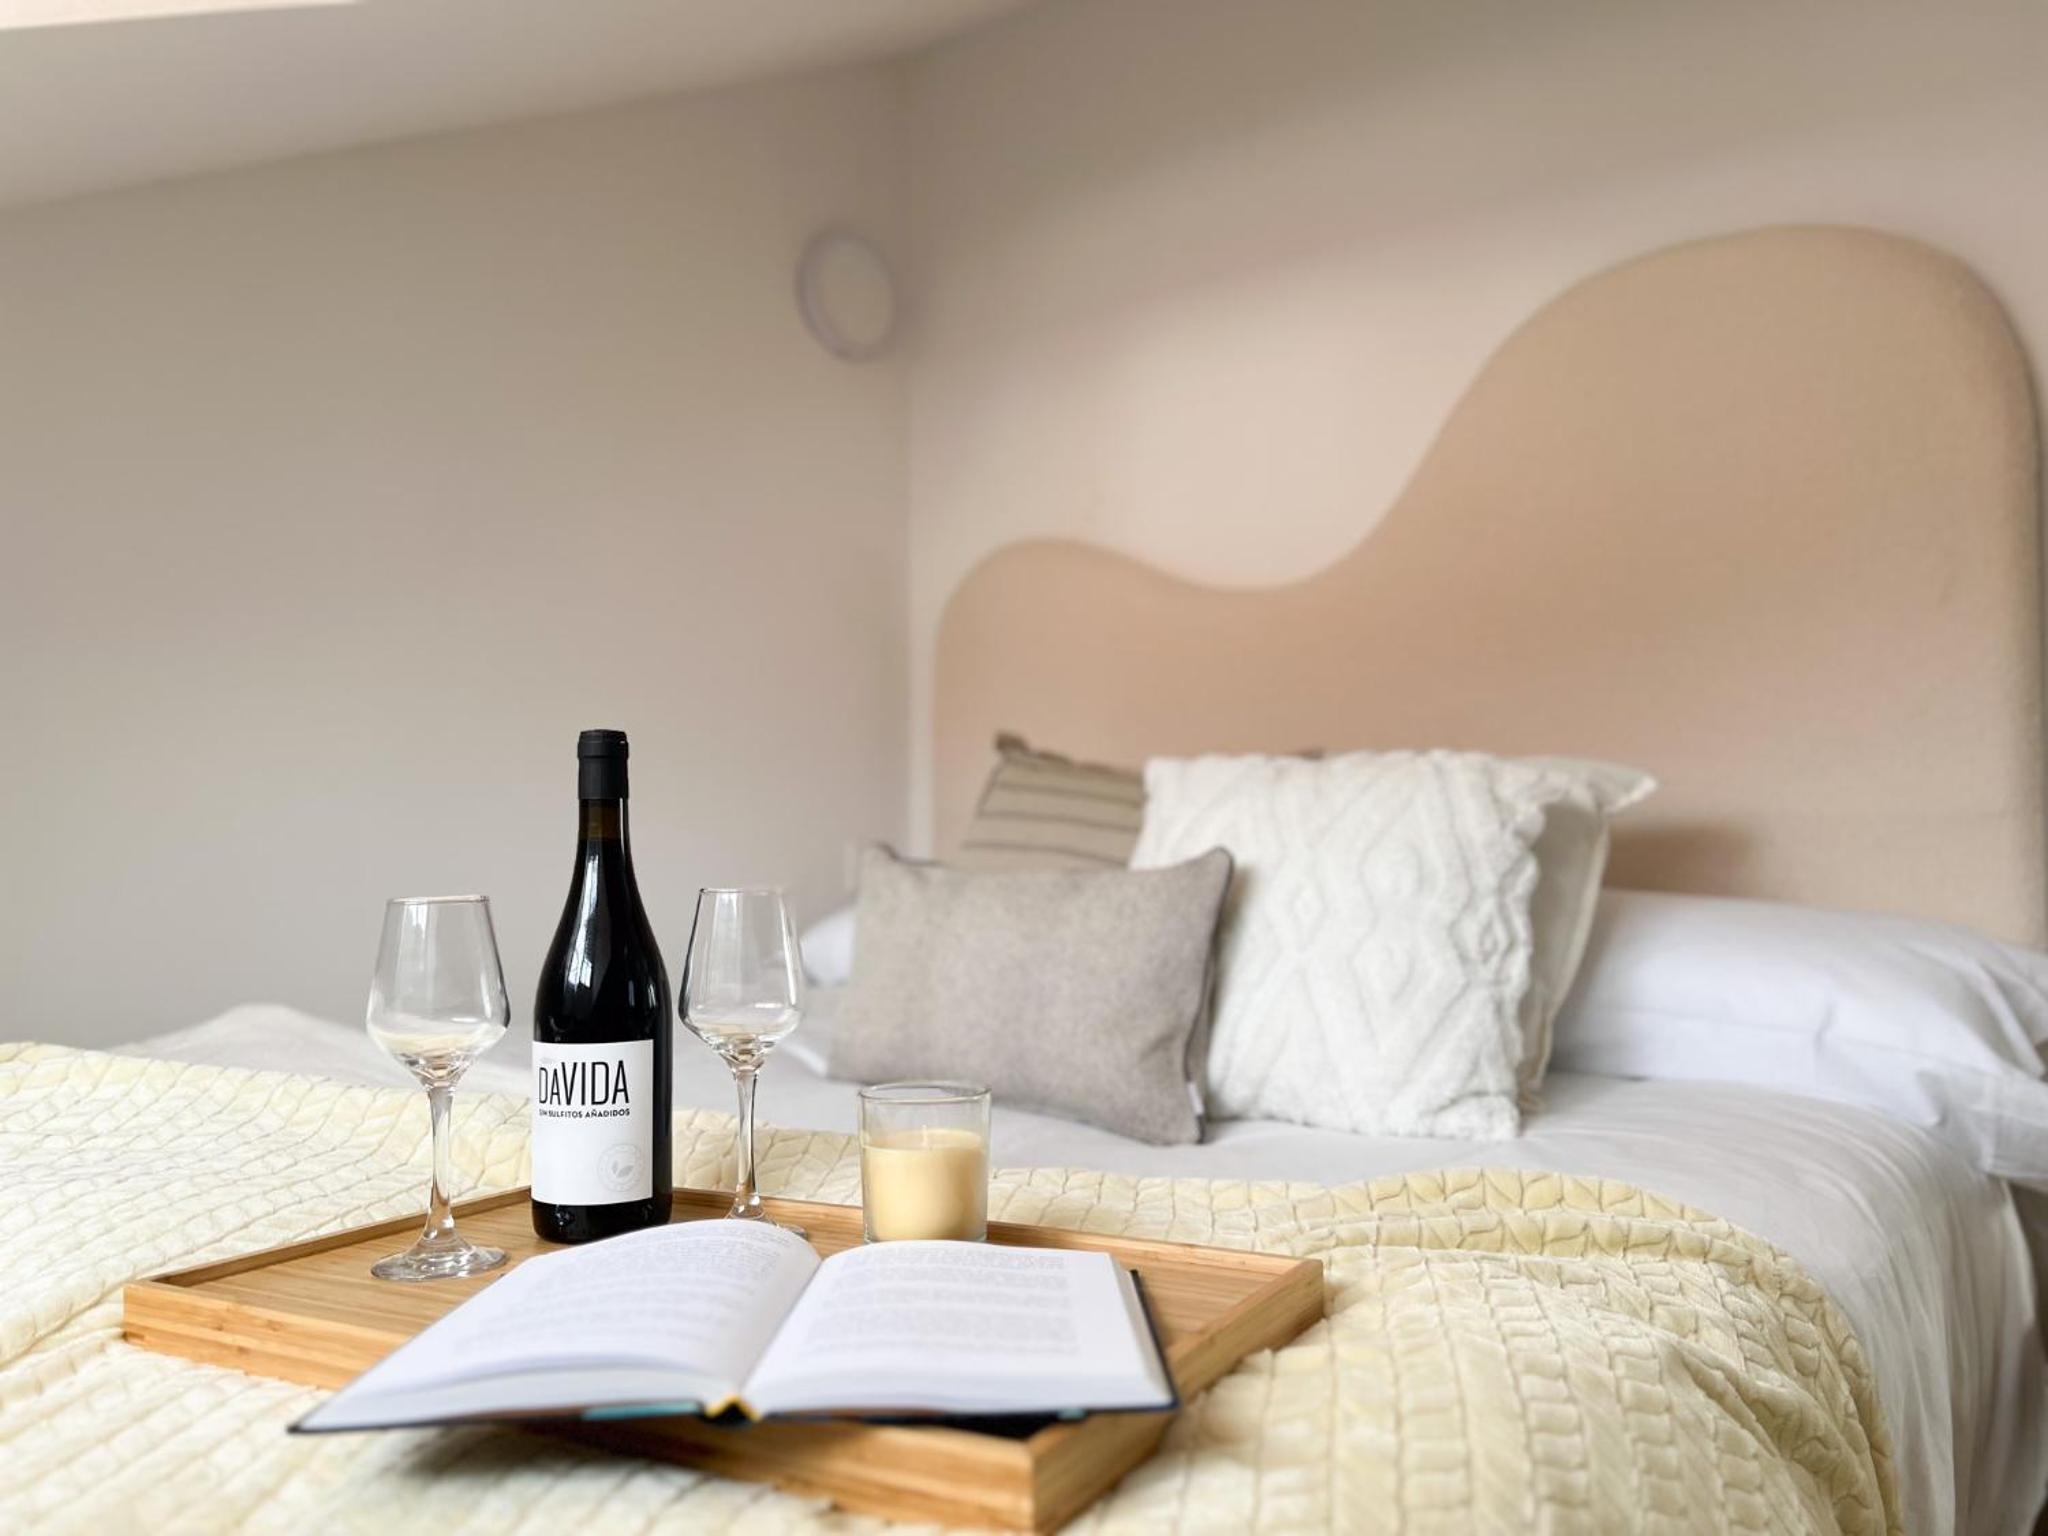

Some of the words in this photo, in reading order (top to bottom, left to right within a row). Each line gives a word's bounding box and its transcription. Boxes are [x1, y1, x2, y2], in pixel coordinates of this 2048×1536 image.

[538, 1060, 630, 1106] DAVIDA
[548, 1109, 583, 1119] SULFITOS
[585, 1108, 631, 1118] AÑADIDOS
